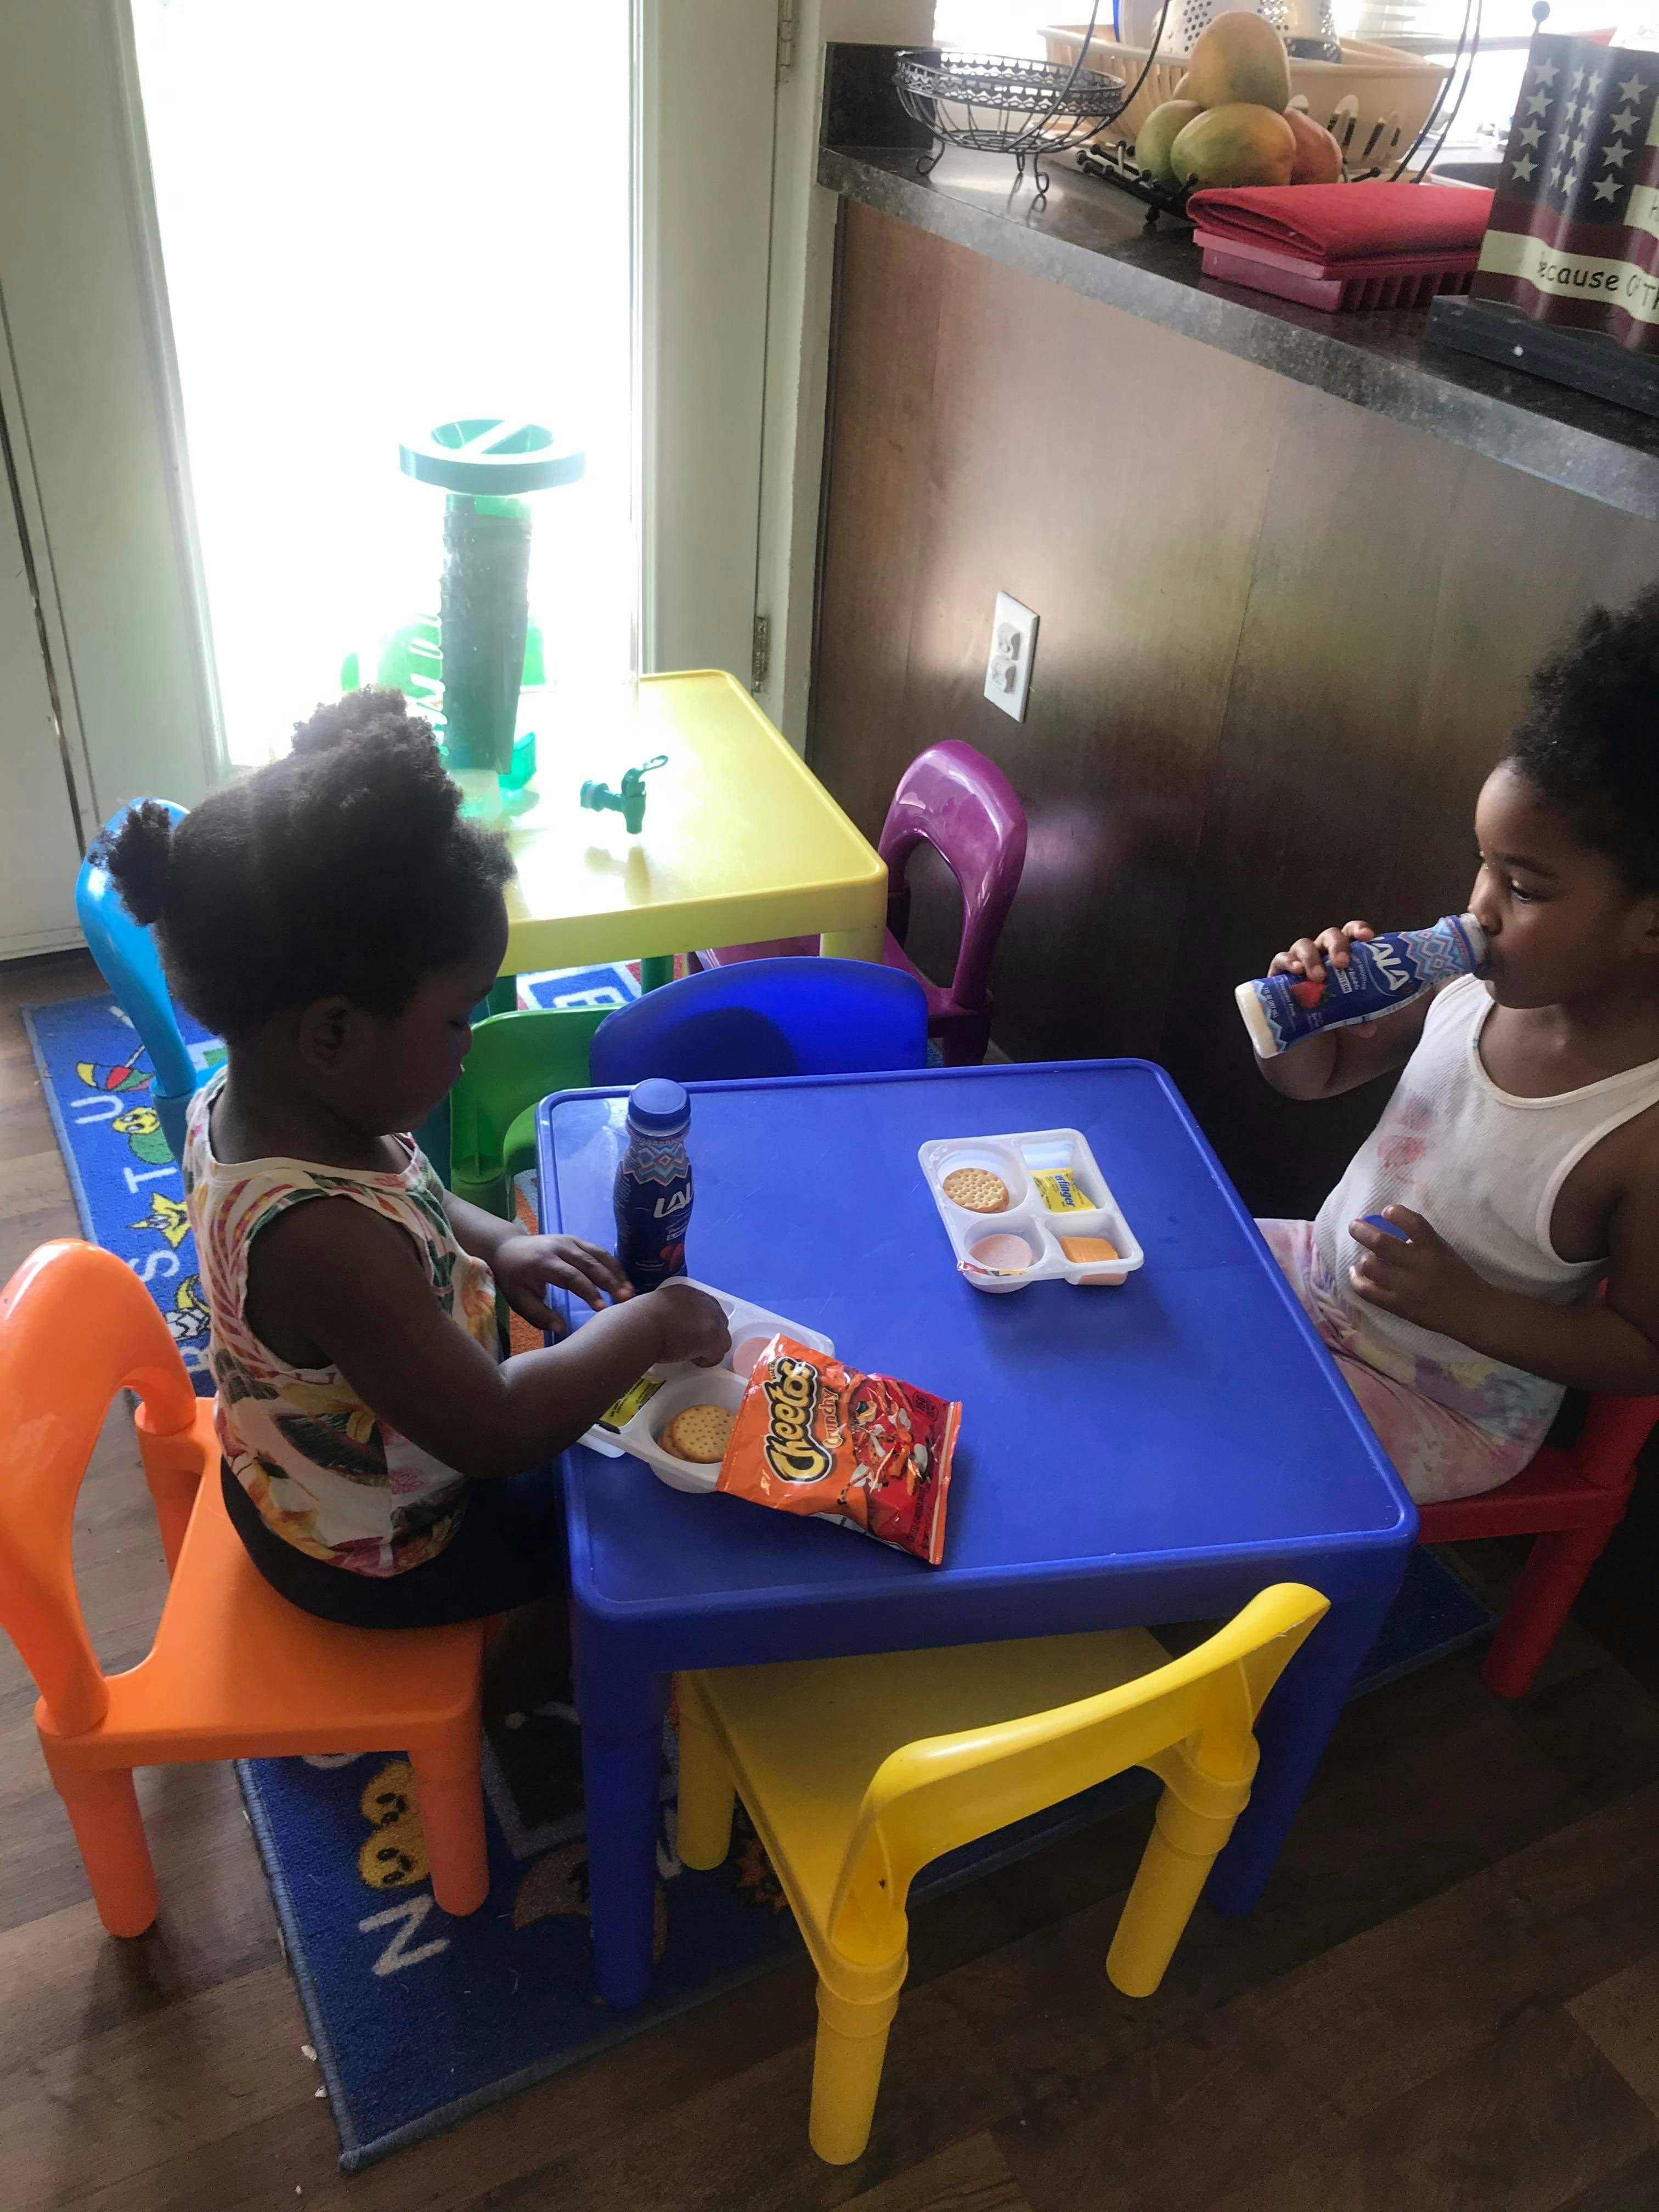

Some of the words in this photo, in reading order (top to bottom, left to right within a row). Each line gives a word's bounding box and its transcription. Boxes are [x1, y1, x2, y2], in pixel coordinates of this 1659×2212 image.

[70, 1094, 125, 1125] U
[123, 1166, 179, 1194] T
[128, 1249, 180, 1283] S
[765, 1357, 831, 1483] Cheetos
[819, 1387, 843, 1448] Crunchy
